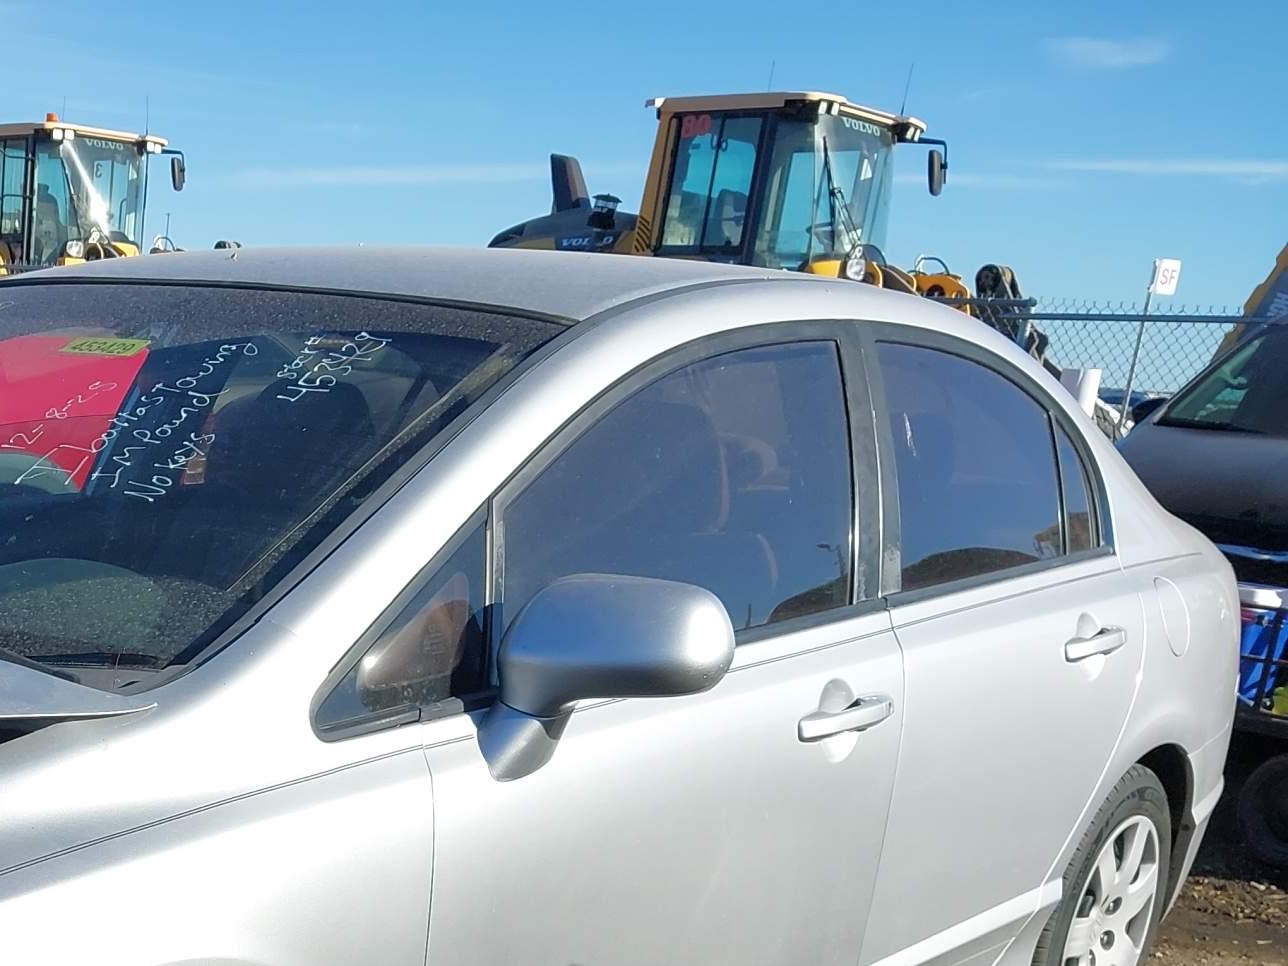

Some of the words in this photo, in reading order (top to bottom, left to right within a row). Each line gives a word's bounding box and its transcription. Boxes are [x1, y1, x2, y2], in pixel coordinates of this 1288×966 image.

[841, 116, 881, 137] VOLVO
[85, 138, 124, 150] VOLVO
[561, 235, 614, 247] VOLO
[1159, 268, 1177, 286] SF
[276, 331, 393, 402] 453429
[123, 476, 174, 502] No
